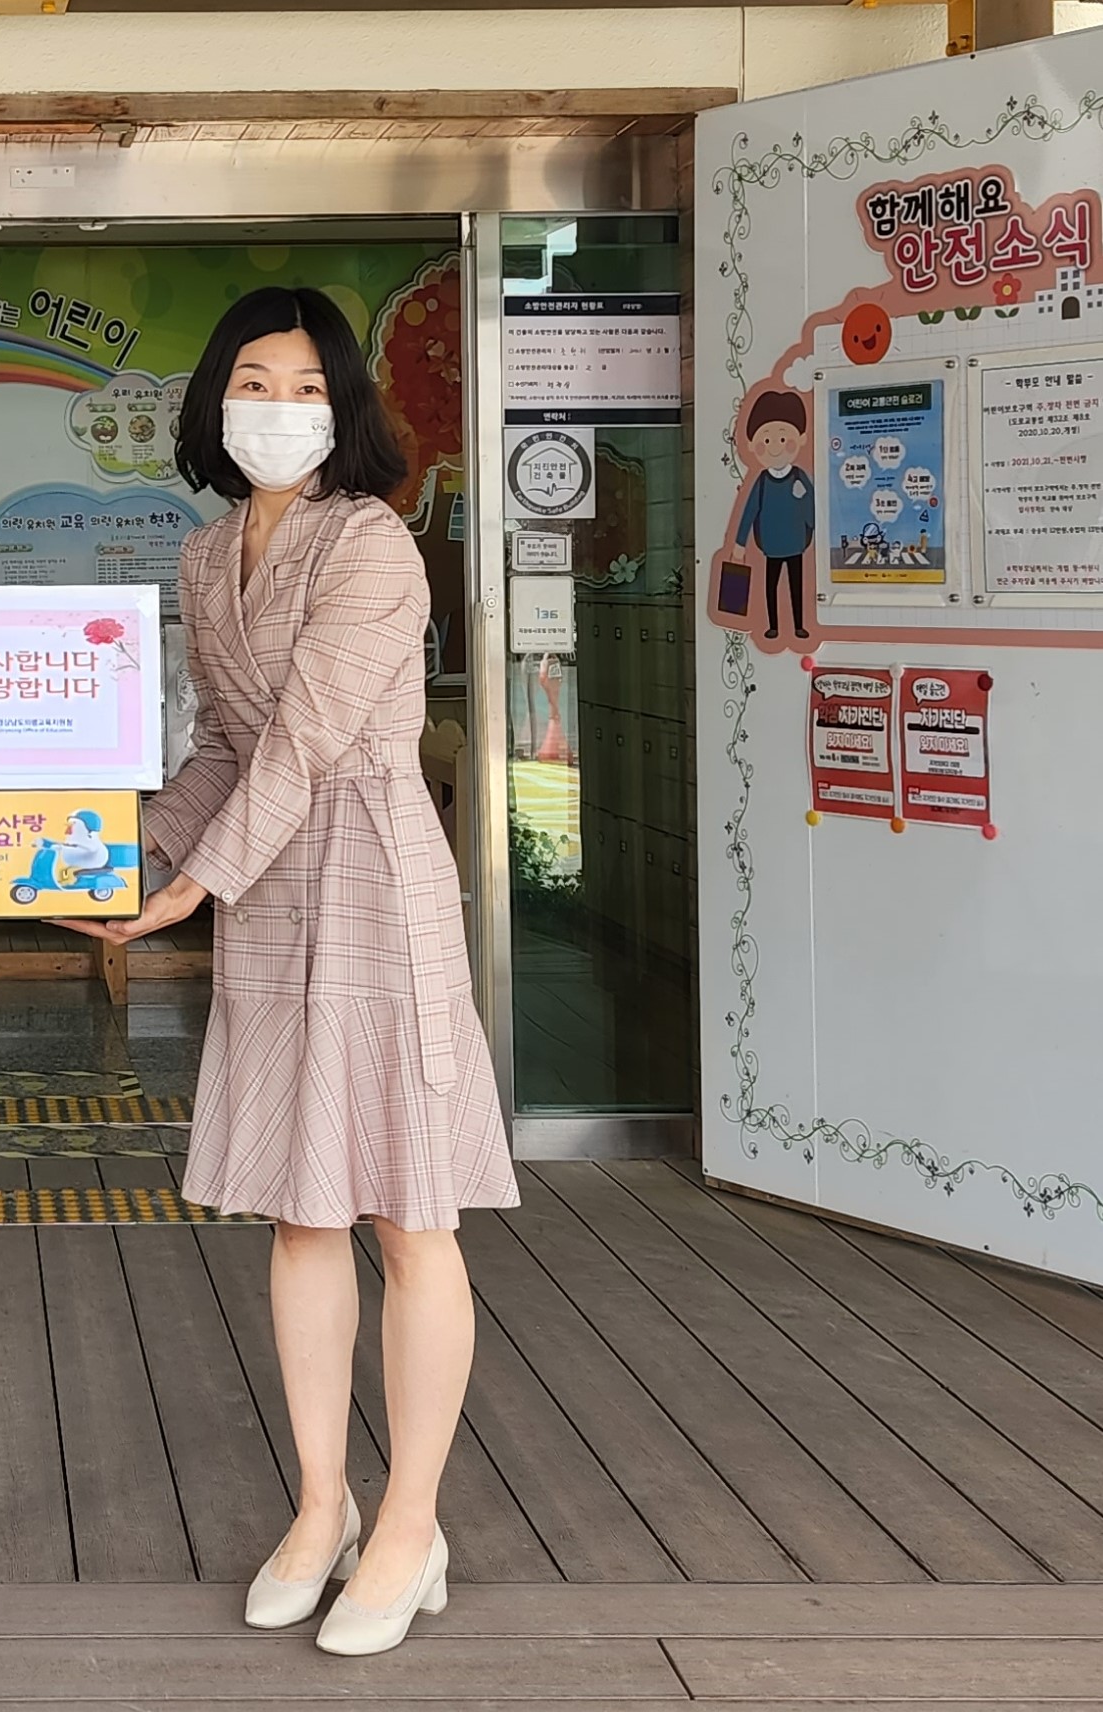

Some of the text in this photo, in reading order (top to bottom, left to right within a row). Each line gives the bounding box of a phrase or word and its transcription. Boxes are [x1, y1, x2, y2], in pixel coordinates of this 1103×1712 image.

[867, 176, 1011, 238] 함께해요
[894, 202, 1091, 291] 안전소식
[29, 289, 140, 369] 어린이
[1016, 377, 1039, 389] 학부모
[1045, 375, 1061, 387] 안내
[112, 388, 130, 398] 우리
[134, 390, 162, 401] 유치원
[847, 397, 870, 408] 어린이
[2, 514, 85, 530] 의령 유치원 교육
[90, 511, 182, 529] 의령 유치원 현황
[839, 705, 884, 727] 자가진단
[920, 707, 967, 729] 자가진단
